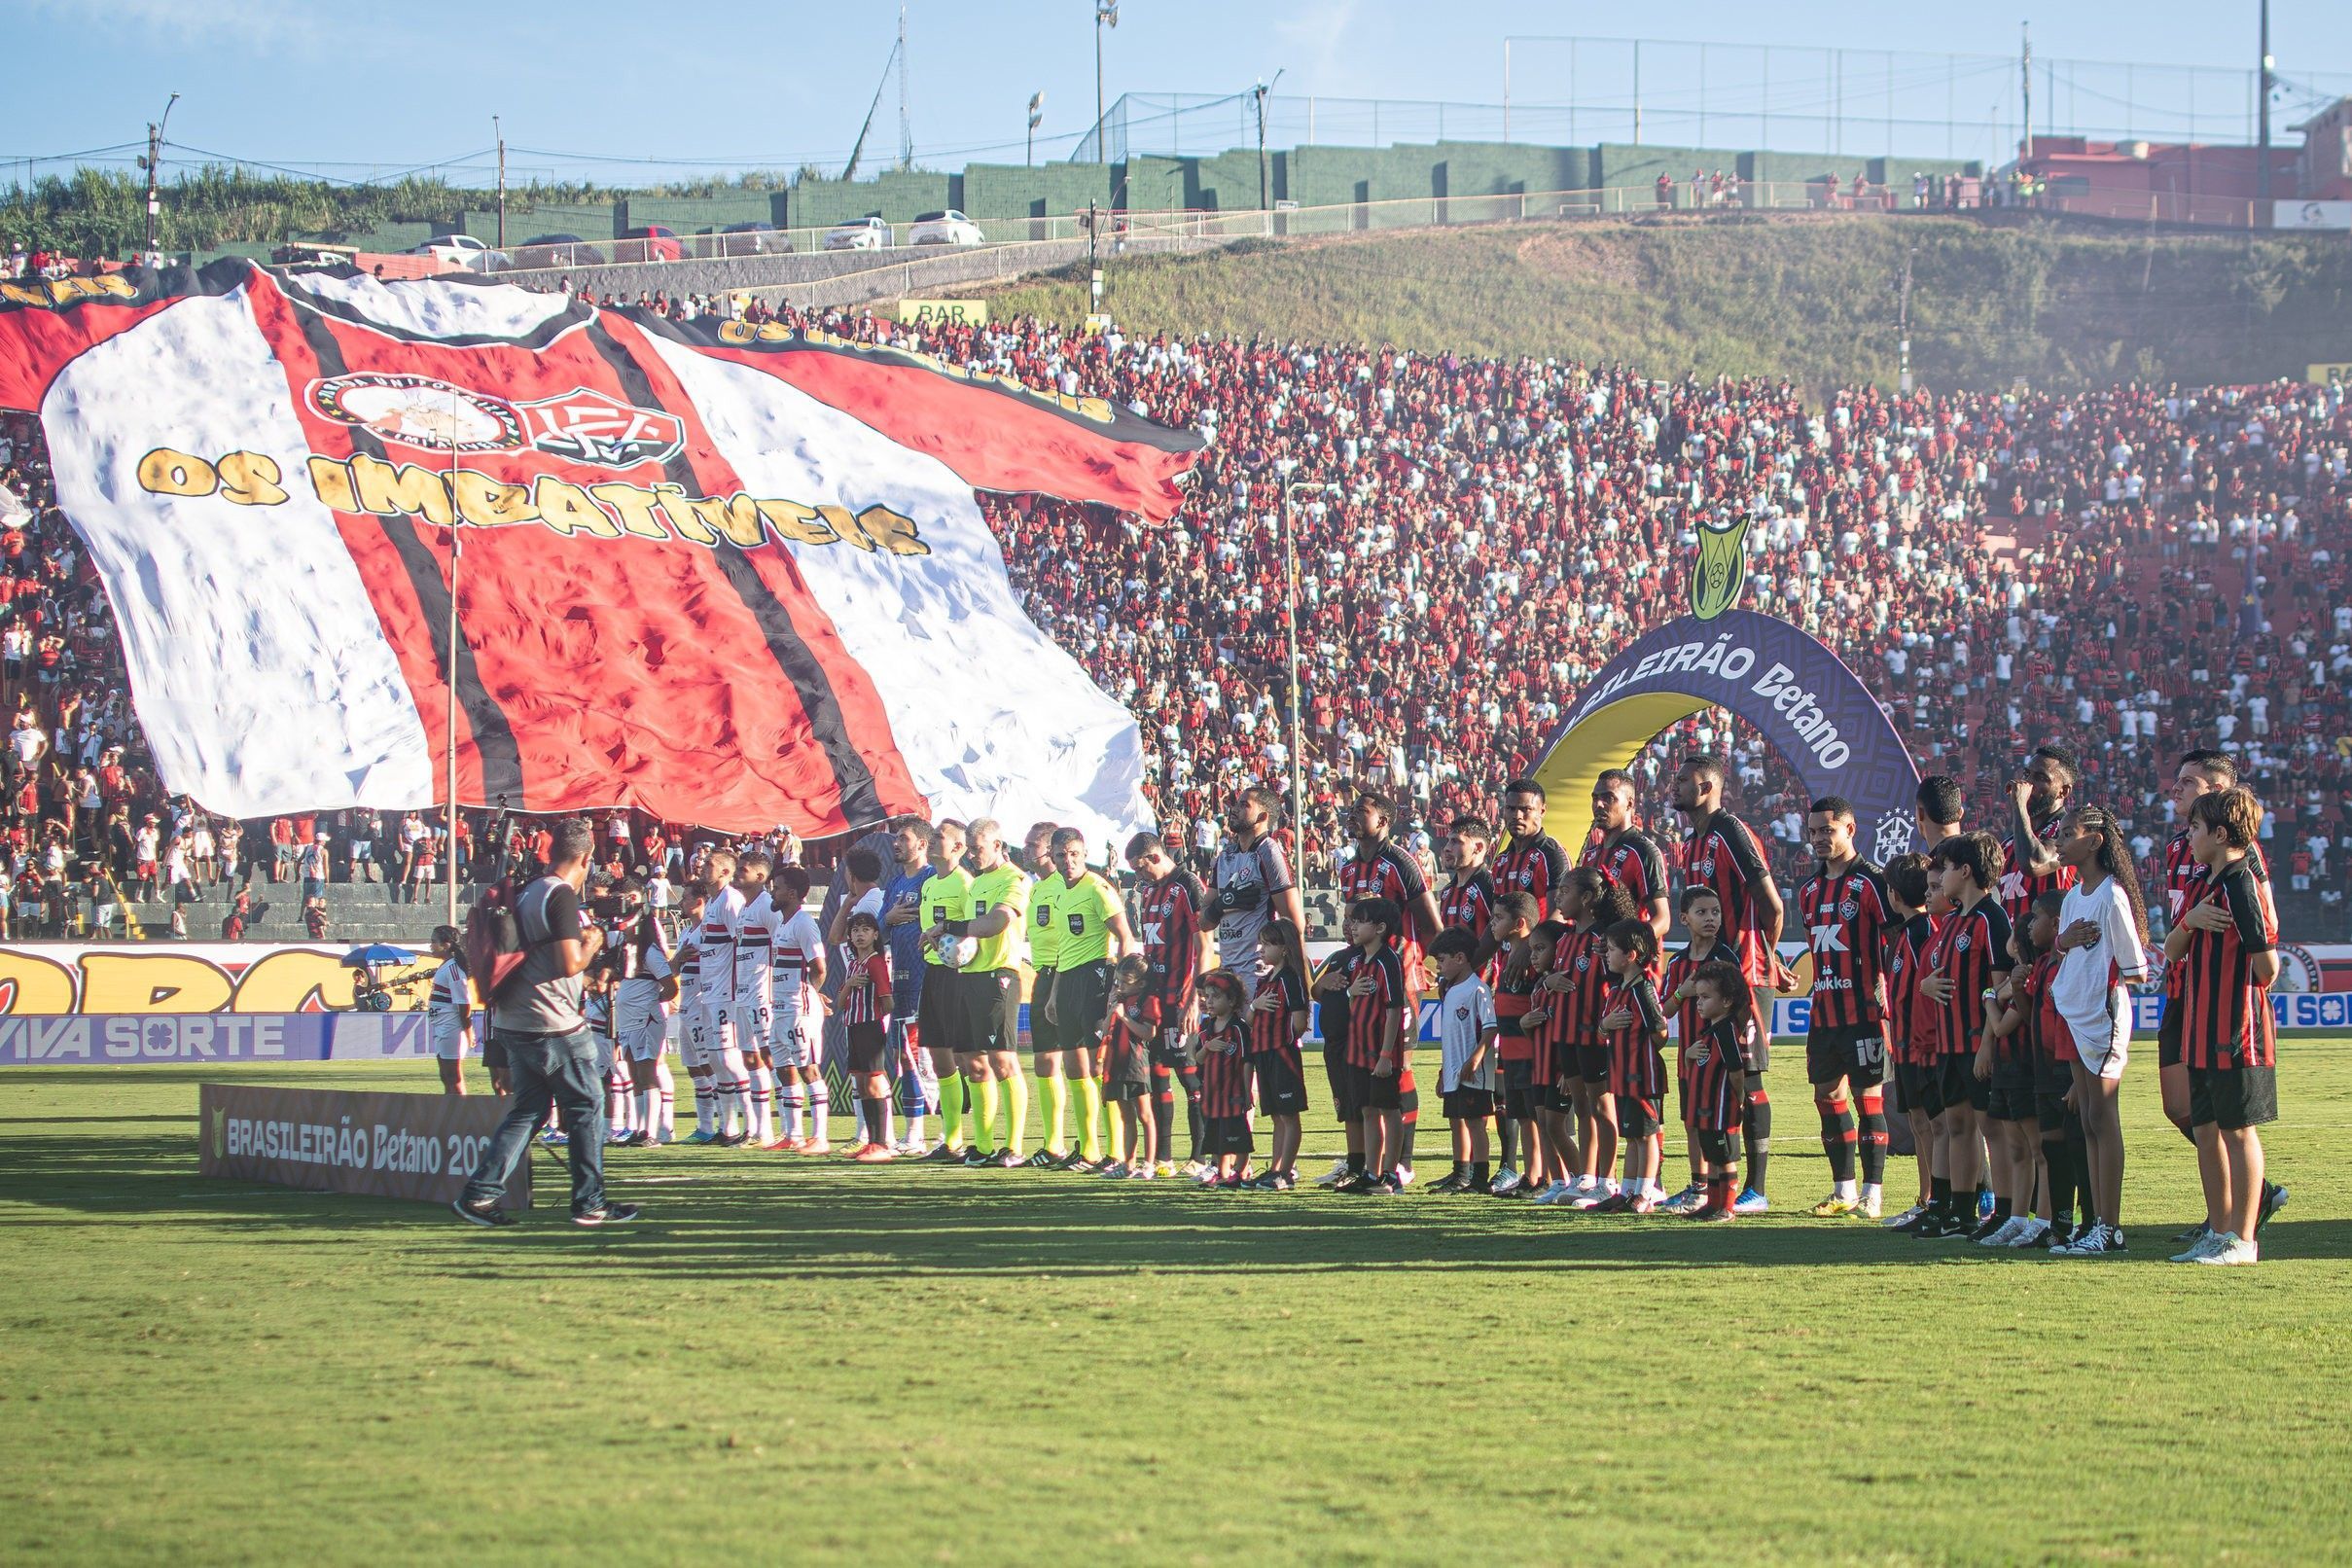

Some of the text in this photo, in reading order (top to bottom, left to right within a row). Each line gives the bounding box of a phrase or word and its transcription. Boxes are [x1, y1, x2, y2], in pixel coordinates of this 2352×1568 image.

[918, 304, 966, 325] BAR
[137, 447, 290, 506] OS
[1751, 661, 1850, 769] Betano
[1810, 923, 1850, 953] 7K
[718, 1009, 728, 1025] 2
[752, 1007, 768, 1025] 19
[105, 1016, 285, 1057] SORTE
[787, 1027, 806, 1046] 94
[228, 1115, 369, 1169] BRASILEIRÃO
[373, 1123, 442, 1174] Betano
